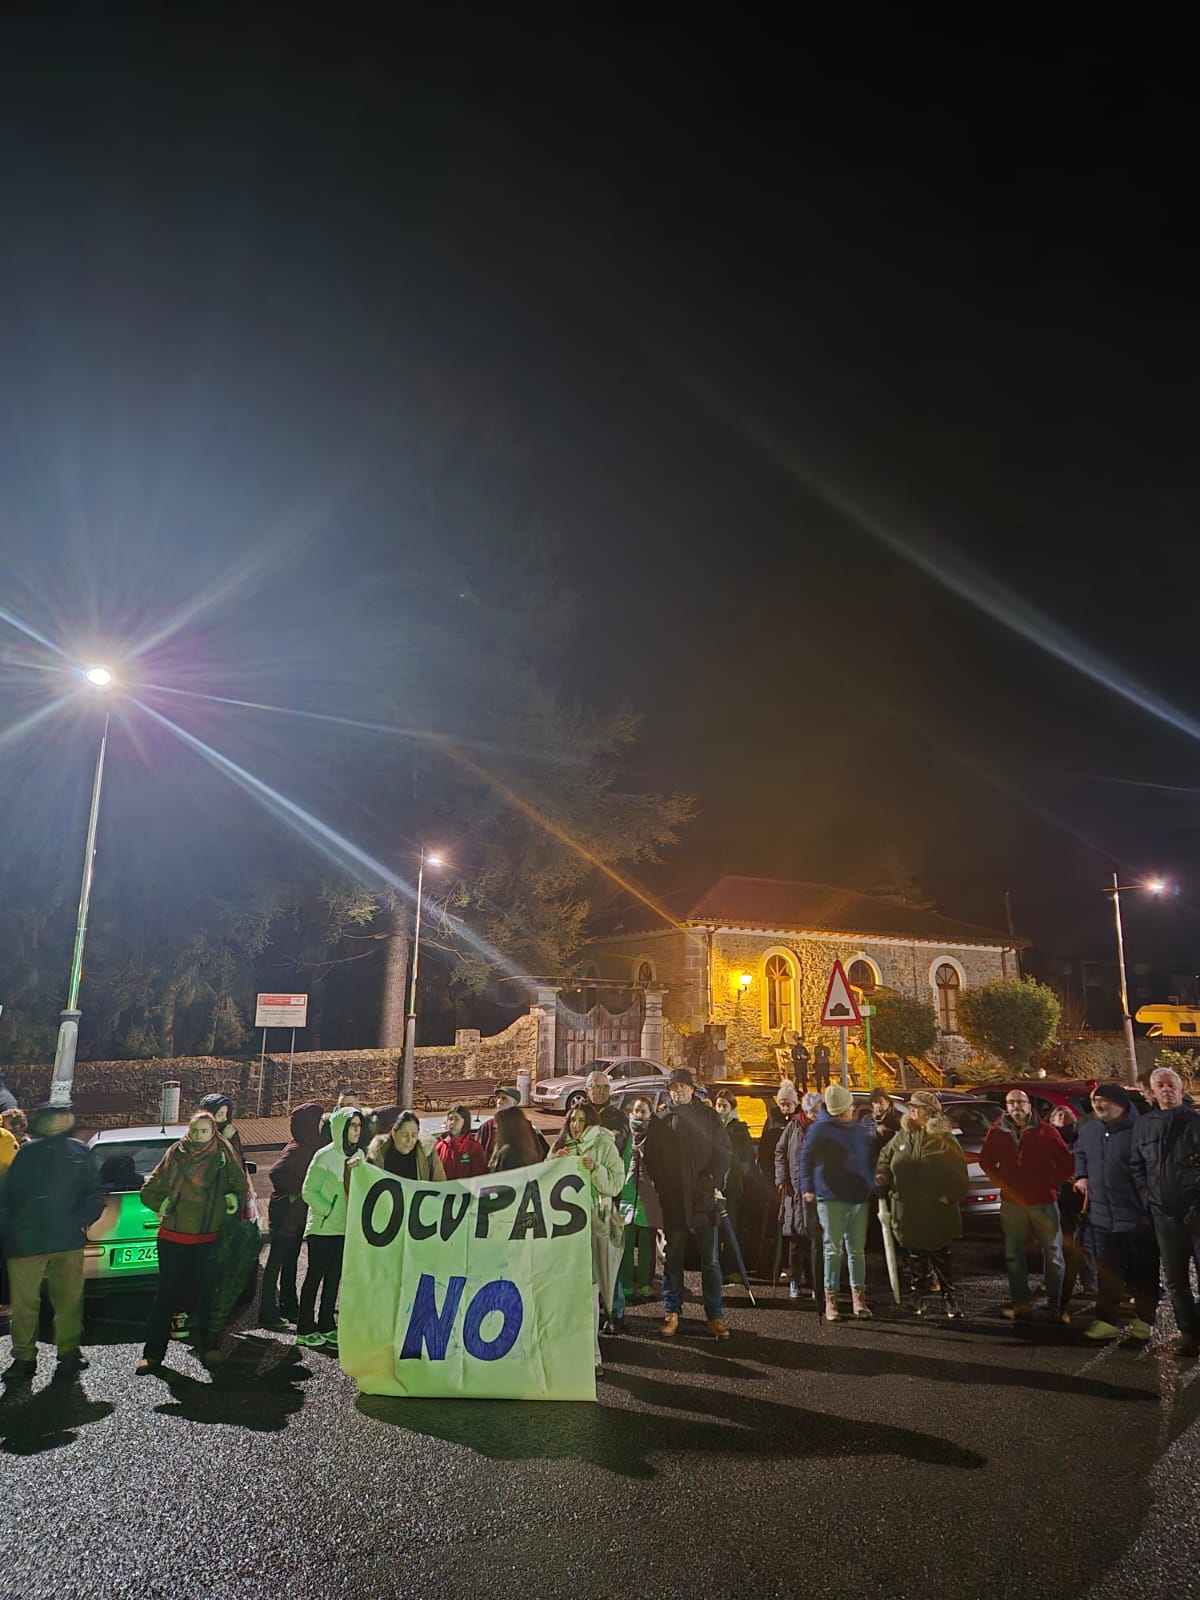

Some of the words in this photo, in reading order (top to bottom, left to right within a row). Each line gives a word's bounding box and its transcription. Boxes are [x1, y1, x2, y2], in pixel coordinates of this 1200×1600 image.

[361, 1174, 588, 1247] OCUPAS
[124, 1249, 132, 1262] S
[399, 1273, 524, 1361] NO
